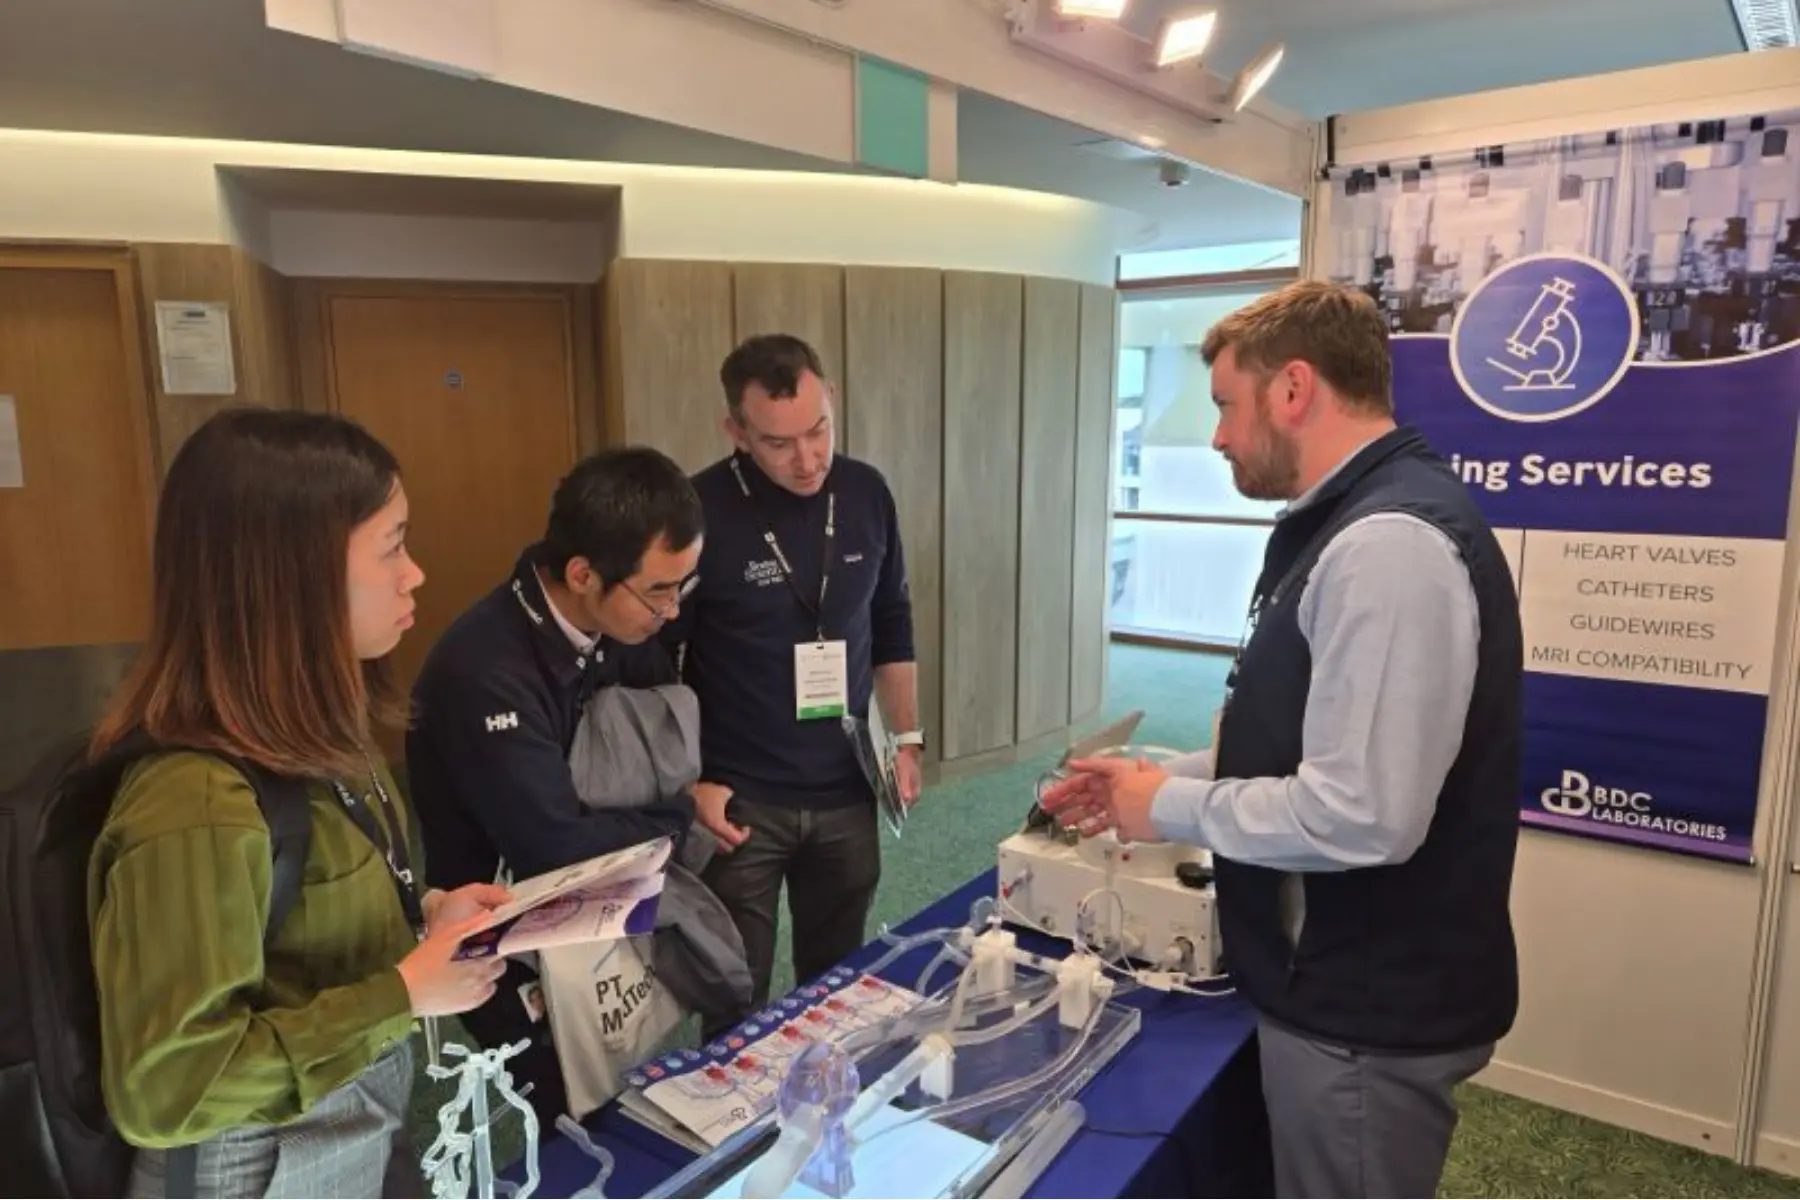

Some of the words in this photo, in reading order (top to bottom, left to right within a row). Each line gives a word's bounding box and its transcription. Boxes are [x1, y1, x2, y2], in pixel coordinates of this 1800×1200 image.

[1520, 454, 1712, 488] Services
[1564, 543, 1639, 561] HEART
[1647, 547, 1736, 567] VALVES
[1576, 578, 1714, 602] CATHETERS
[1570, 613, 1715, 640] GUIDEWIRES
[1531, 646, 1569, 663] MRI
[1576, 650, 1752, 681] COMPATIBILITY
[485, 711, 518, 732] HH
[1593, 786, 1653, 812] BDC
[1592, 808, 1727, 841] LABORATORIES
[595, 974, 622, 1005] PT
